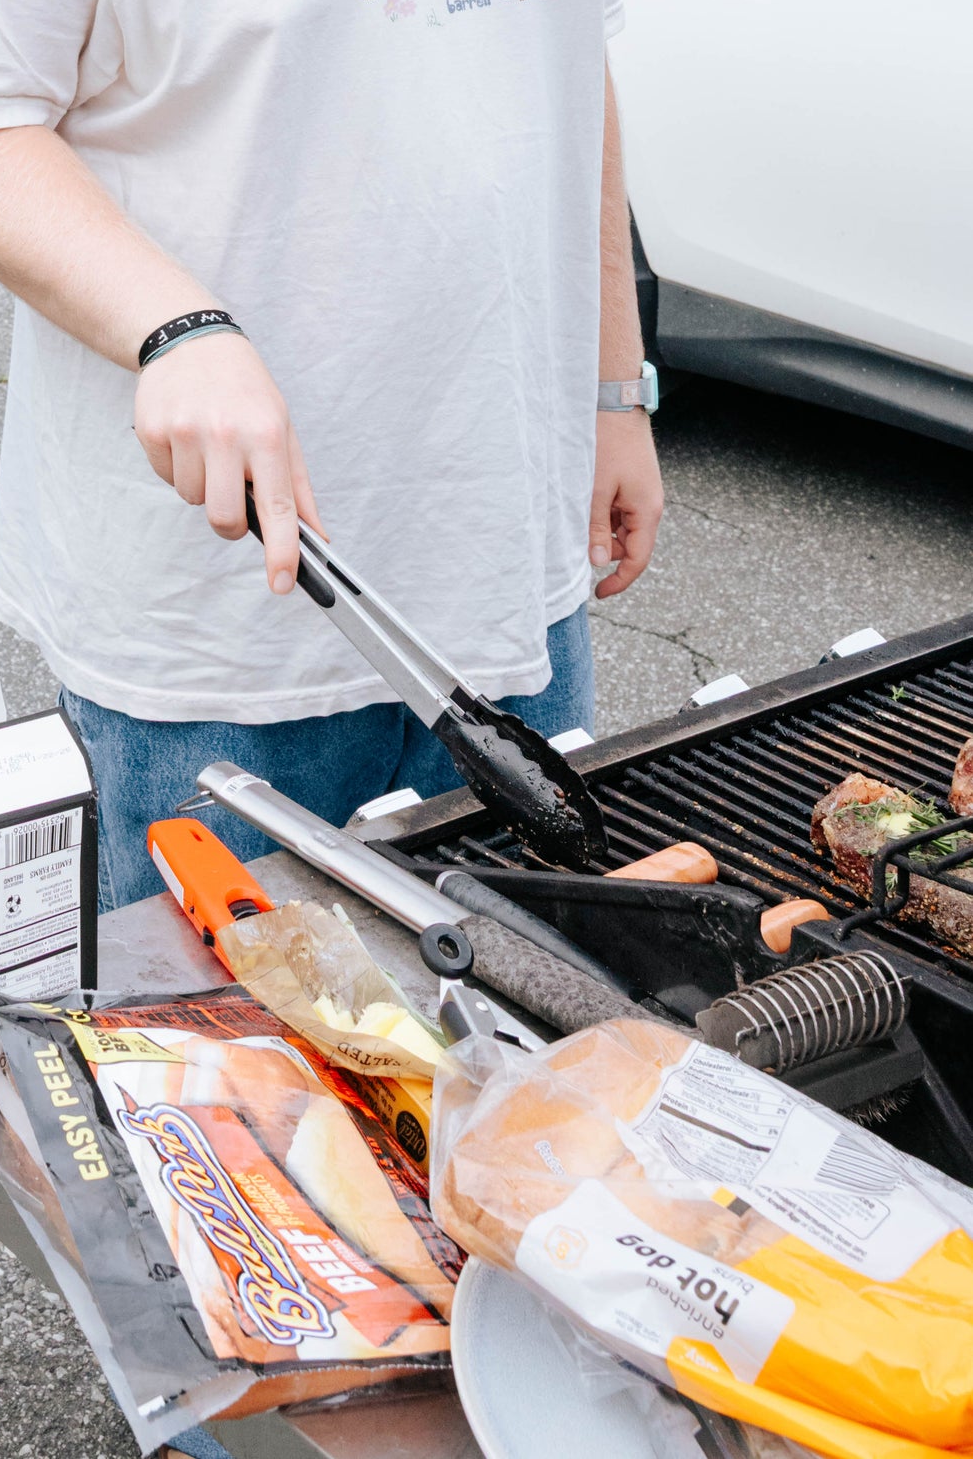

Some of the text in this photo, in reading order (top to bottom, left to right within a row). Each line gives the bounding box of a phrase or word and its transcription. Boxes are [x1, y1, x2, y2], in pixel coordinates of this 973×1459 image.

[13, 821, 37, 835] 00026
[41, 814, 64, 827] 62315
[3, 873, 22, 884] IRELAND
[29, 858, 71, 878] FAMILY FARMS
[34, 1044, 110, 1182] EASY PEEL
[662, 1093, 690, 1111] Protein
[129, 1113, 324, 1338] Ball Park
[281, 1228, 376, 1293] BEEF
[615, 1233, 676, 1269] dog
[676, 1266, 740, 1325] hot
[711, 1267, 755, 1295] buns
[645, 1277, 725, 1340] enriched
